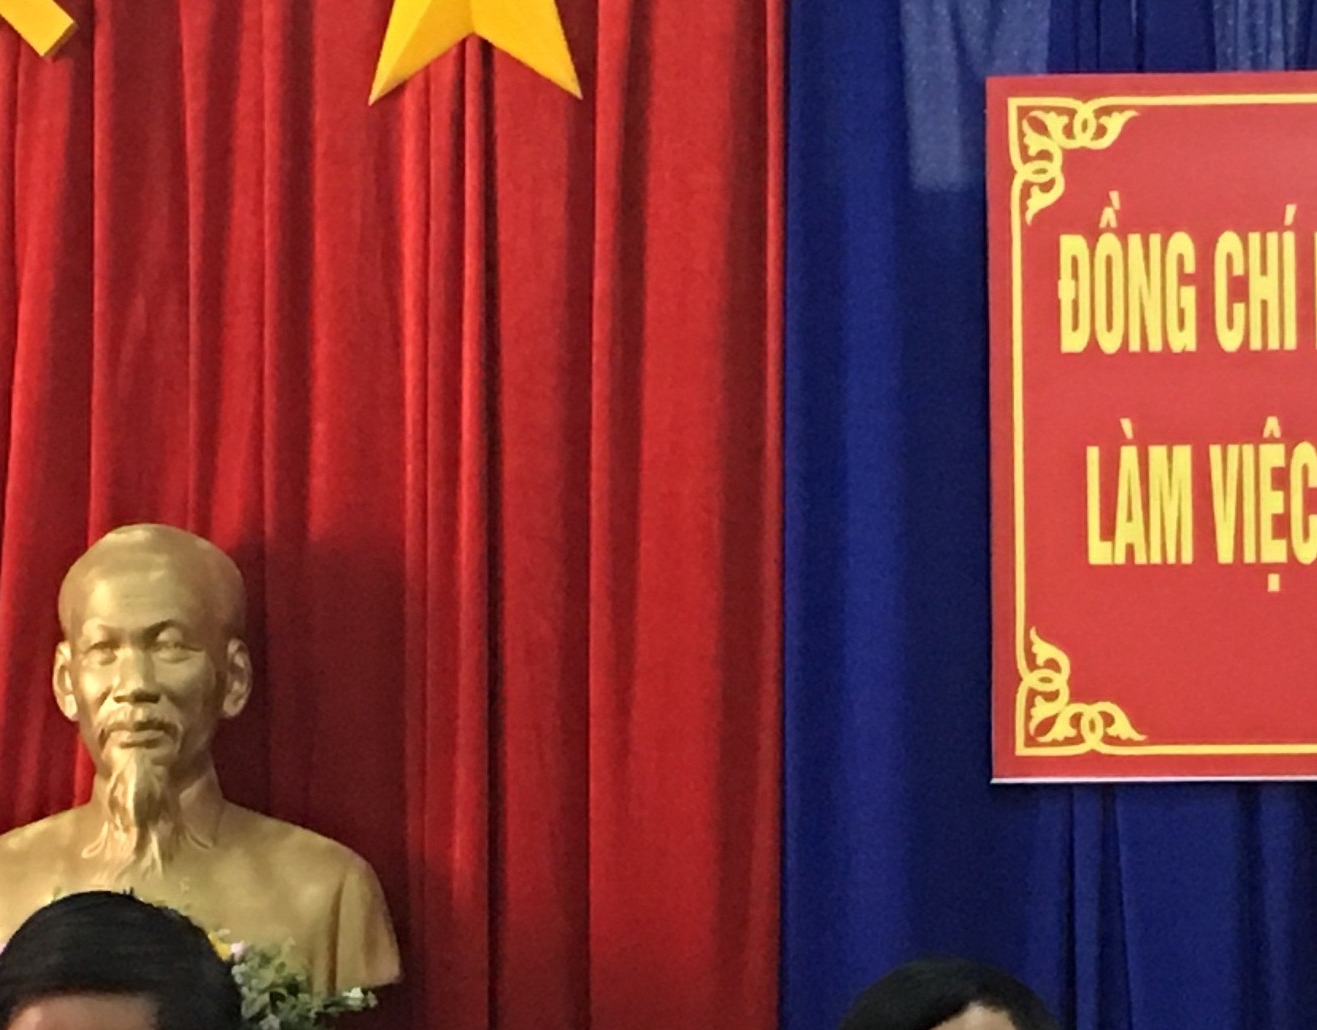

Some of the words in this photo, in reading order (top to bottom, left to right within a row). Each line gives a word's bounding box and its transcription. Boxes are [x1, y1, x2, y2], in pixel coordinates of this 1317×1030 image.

[1058, 190, 1197, 354] ĐỒNG
[1214, 204, 1297, 352] CHÍ
[1087, 418, 1193, 565] LÀM
